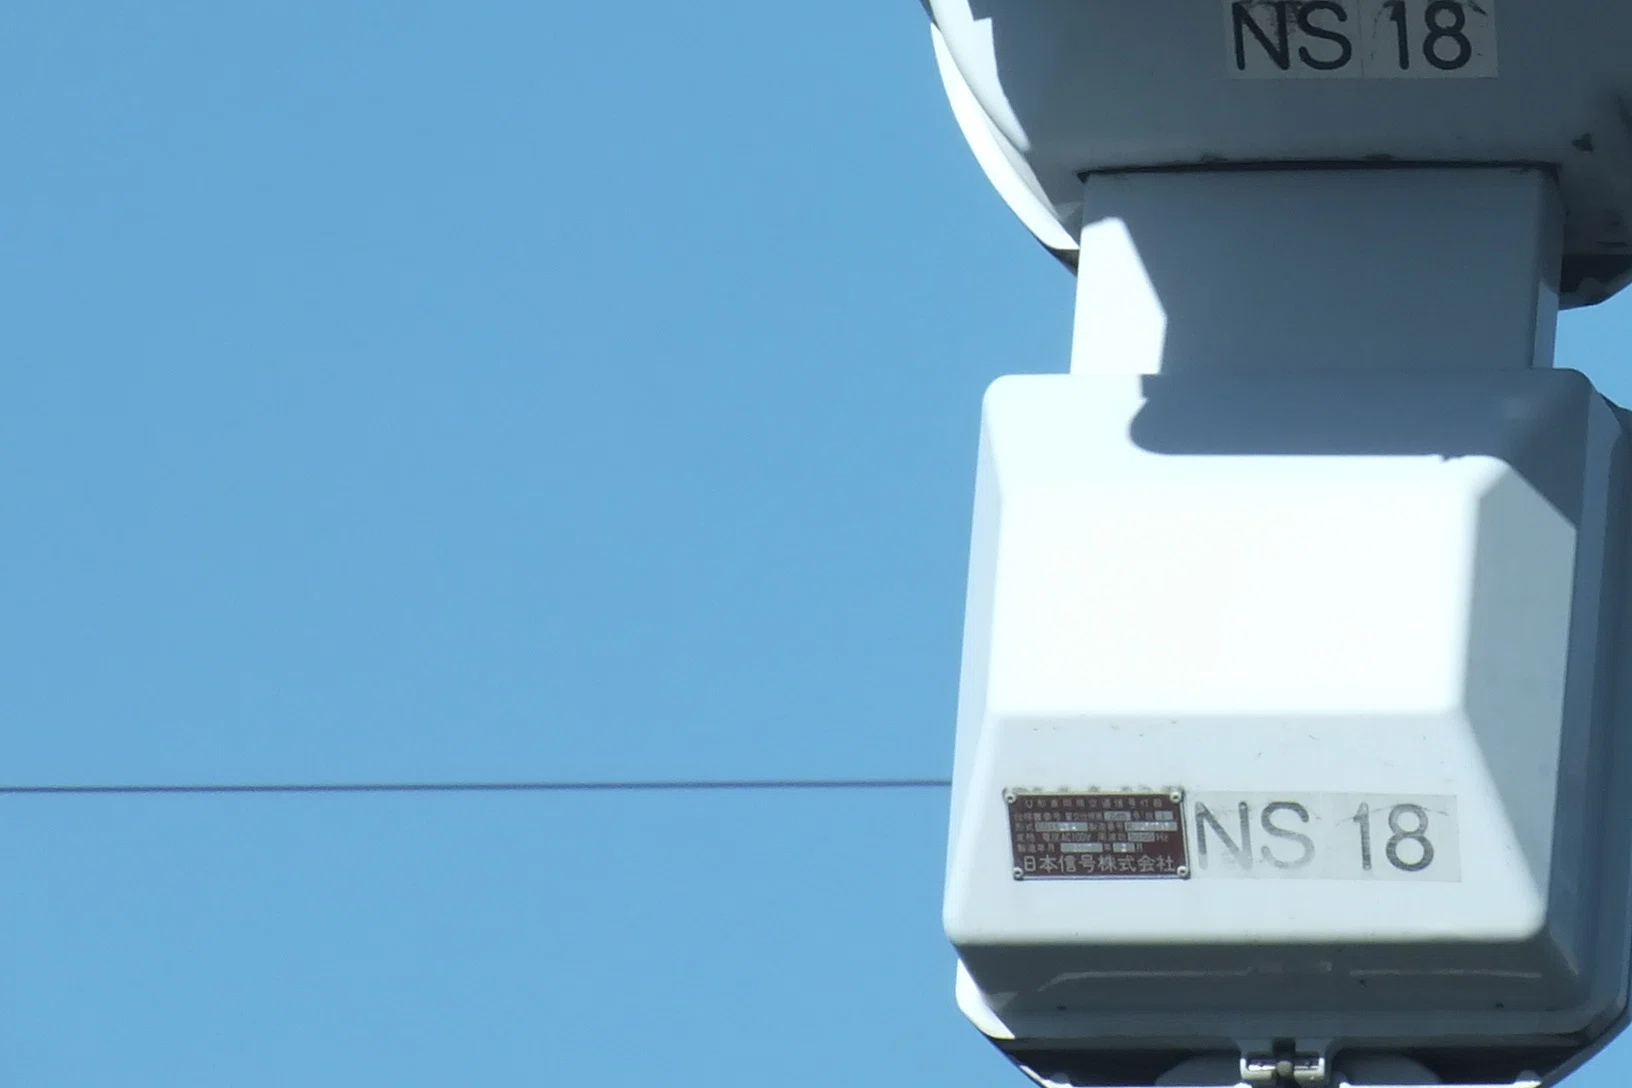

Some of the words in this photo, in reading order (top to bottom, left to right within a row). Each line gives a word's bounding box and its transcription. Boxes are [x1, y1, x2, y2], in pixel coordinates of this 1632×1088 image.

[1231, 0, 1352, 70] NS
[1382, 0, 1472, 70] 18
[1023, 854, 1176, 873] 日本信号株式会社
[1194, 801, 1316, 870] NS
[1353, 802, 1435, 872] 18
